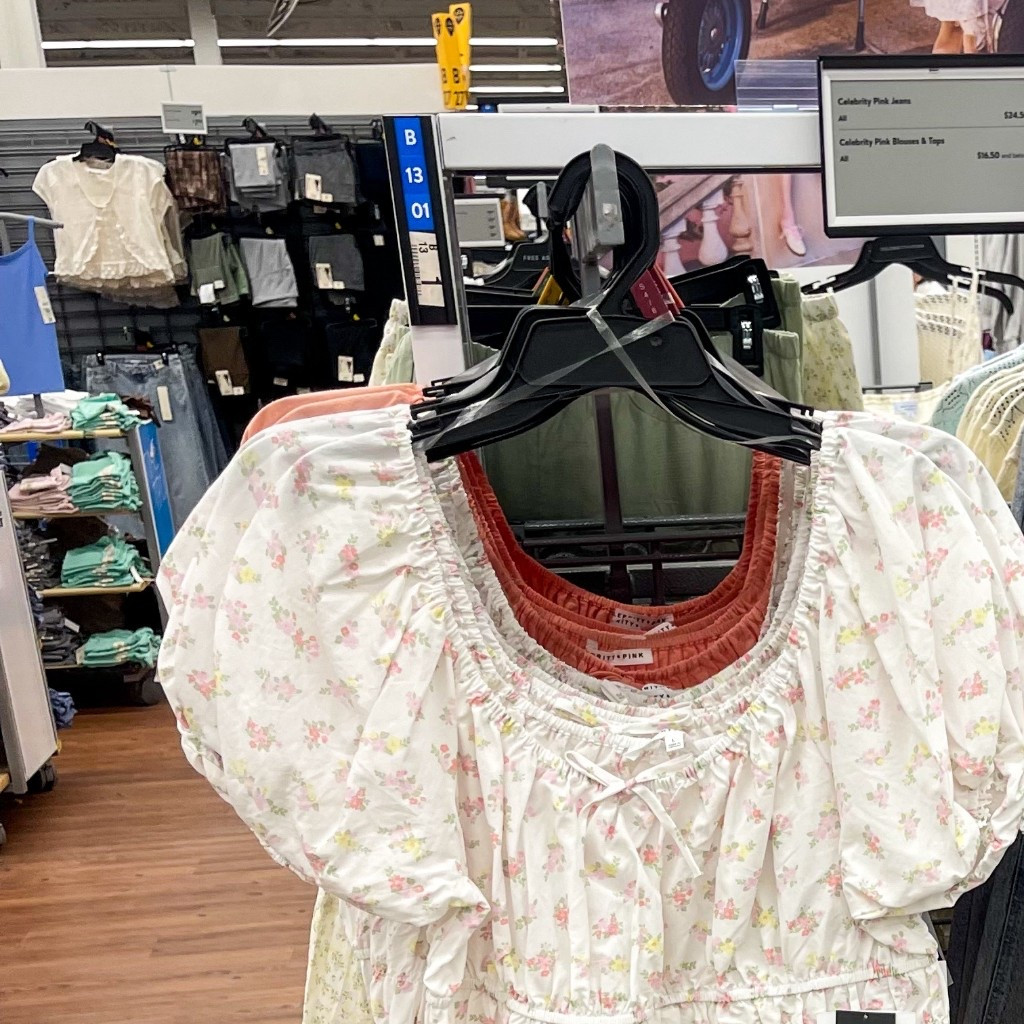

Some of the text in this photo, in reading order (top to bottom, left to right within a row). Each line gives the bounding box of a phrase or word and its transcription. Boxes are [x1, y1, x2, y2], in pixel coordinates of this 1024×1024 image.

[837, 97, 911, 107] Celebrity Pink Jeans
[404, 129, 417, 146] B
[839, 138, 873, 148] Celebrity
[874, 137, 890, 145] Pink
[892, 137, 919, 145] Blouses
[928, 136, 945, 146] Tops
[977, 151, 1000, 159] $16.50
[405, 167, 424, 183] 13
[411, 203, 430, 218] 01
[418, 241, 429, 254] 13
[622, 652, 643, 660] PINK
